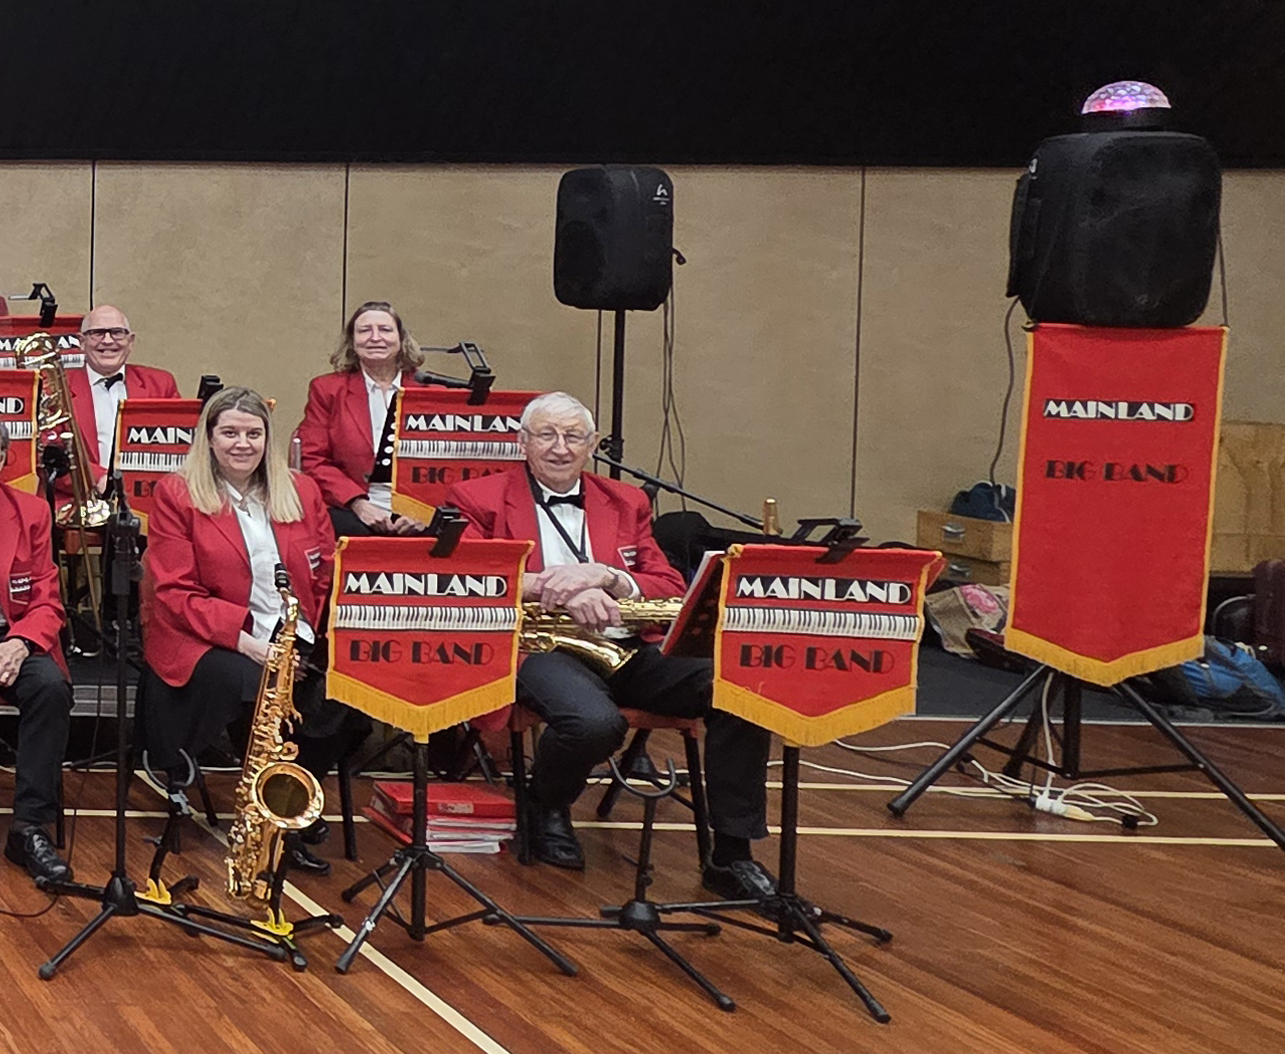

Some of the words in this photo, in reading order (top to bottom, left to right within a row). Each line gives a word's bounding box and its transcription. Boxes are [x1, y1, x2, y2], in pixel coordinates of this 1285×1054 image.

[1043, 400, 1194, 421] MAINLAND
[406, 414, 521, 432] MAINLAN
[127, 427, 193, 444] MAIN
[412, 466, 455, 484] BIG
[1046, 460, 1097, 480] BIG
[1104, 463, 1190, 484] BAND
[344, 572, 508, 597] MAINLAND
[736, 577, 912, 604] MAINLAND
[350, 639, 403, 663] BIG
[412, 641, 495, 665] BAND
[740, 643, 796, 669] BIG
[805, 646, 896, 674] BAND
